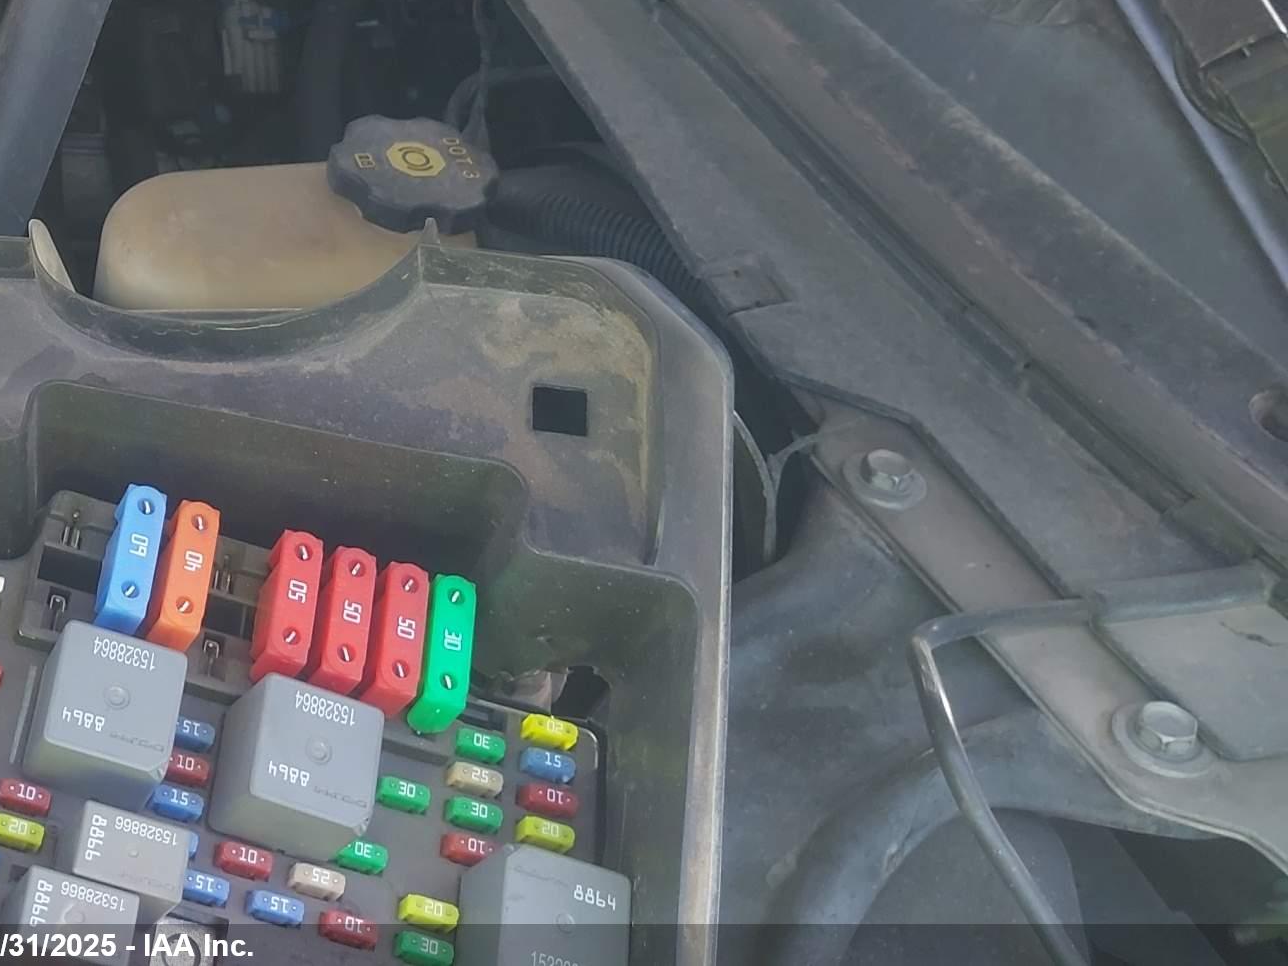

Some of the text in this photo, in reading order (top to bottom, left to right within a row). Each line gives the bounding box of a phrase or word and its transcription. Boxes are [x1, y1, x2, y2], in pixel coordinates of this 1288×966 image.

[442, 137, 480, 179] DOT 3
[129, 534, 149, 558] 60
[184, 550, 204, 572] 40
[288, 579, 308, 604] 50
[343, 599, 362, 624] 50
[397, 616, 416, 640] 50
[444, 628, 462, 651] 30
[93, 636, 156, 671] 15328864
[295, 689, 356, 727] 15328864
[62, 706, 105, 732] 8864
[183, 720, 201, 736] 15
[546, 720, 563, 735] 20
[473, 733, 490, 749] 30
[177, 754, 194, 771] 10
[545, 752, 561, 768] 15
[268, 760, 310, 787] 8864
[472, 768, 489, 783] 25
[17, 784, 36, 800] 10
[170, 788, 188, 806] 15
[398, 781, 416, 798] 30
[547, 789, 564, 804] 10
[471, 802, 488, 818] 30
[8, 818, 28, 835] 20
[114, 816, 177, 846] 15328866
[542, 822, 559, 837] 20
[85, 814, 108, 861] 8866
[239, 847, 257, 864] 10
[354, 841, 373, 858] 30
[468, 839, 485, 855] 10
[195, 875, 214, 892] 15
[312, 868, 330, 884] 25
[29, 879, 53, 927] 8866
[60, 881, 126, 911] 15328866
[270, 896, 290, 914] 15
[574, 884, 616, 911] 8864
[423, 900, 443, 917] 20
[345, 916, 364, 934] 10
[420, 937, 439, 955] 30
